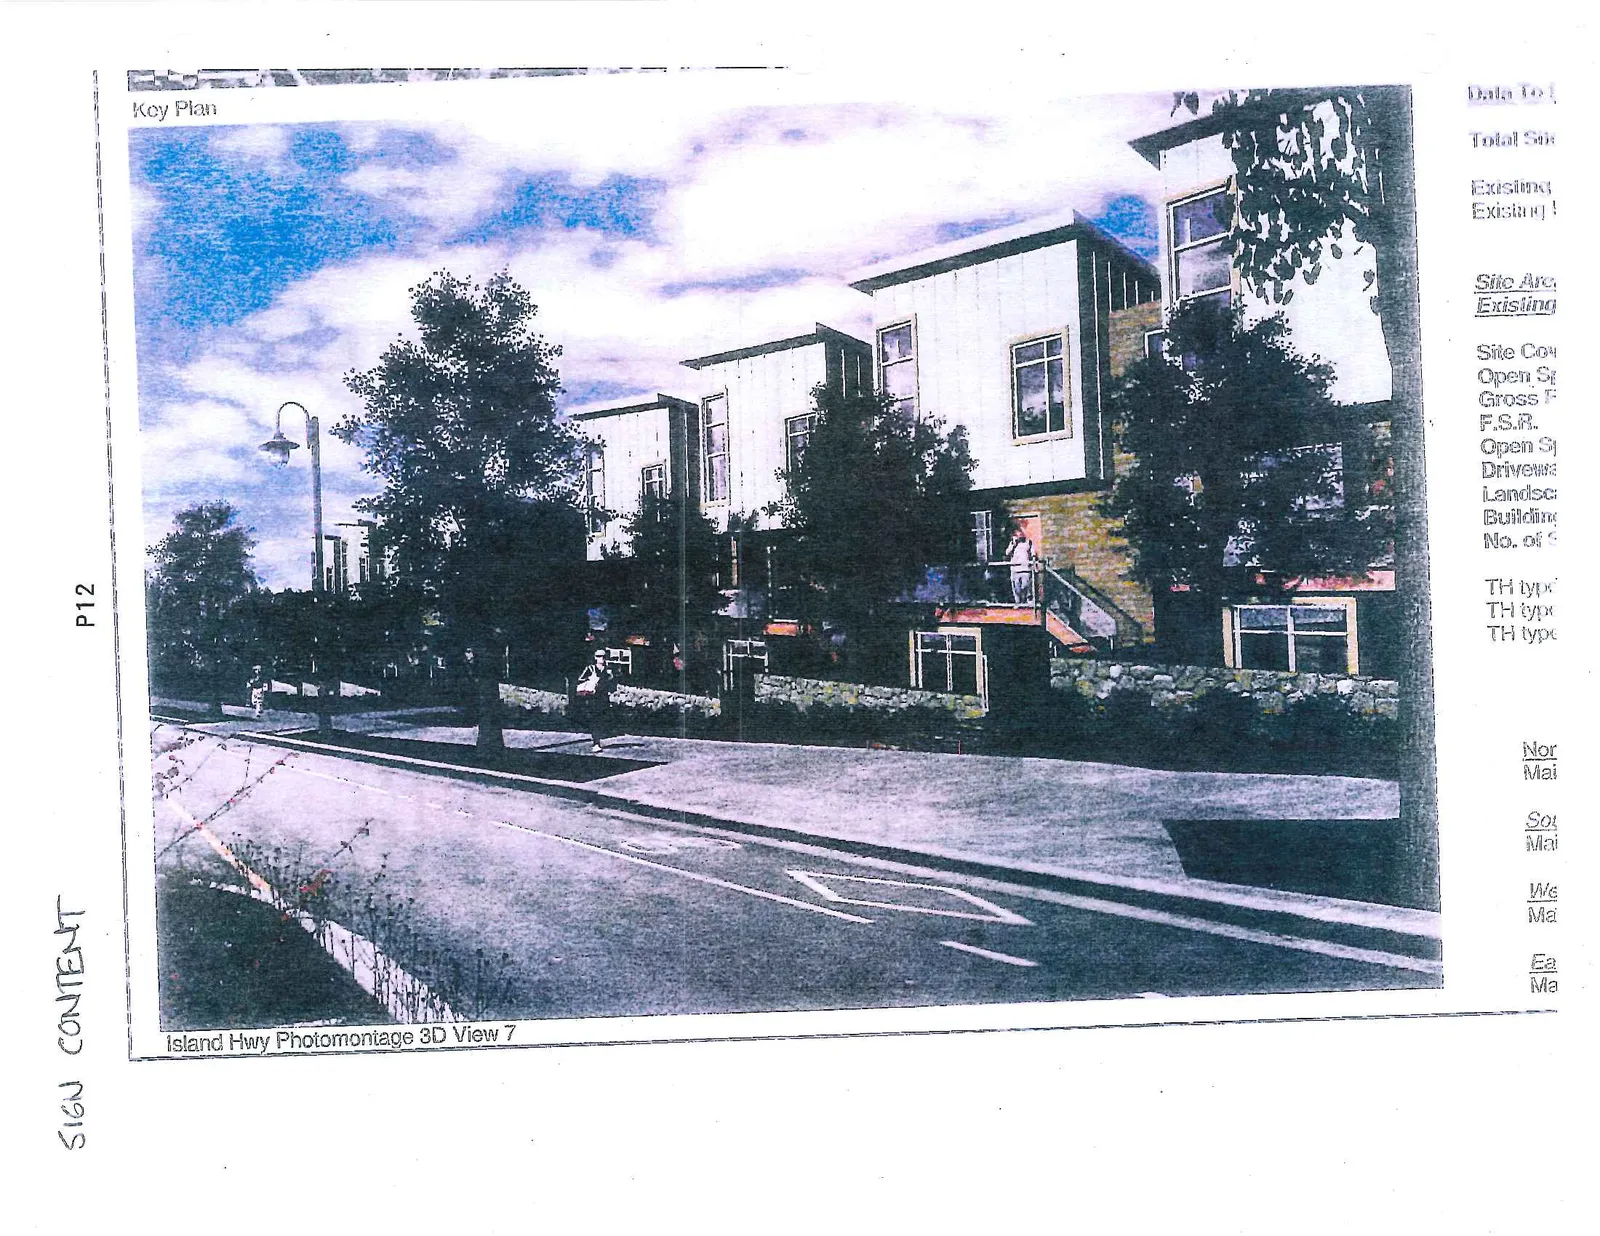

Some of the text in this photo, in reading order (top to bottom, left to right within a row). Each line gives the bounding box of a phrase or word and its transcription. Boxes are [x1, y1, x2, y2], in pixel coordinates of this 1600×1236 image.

[133, 100, 217, 121] Key Plan
[1469, 130, 1518, 148] Total
[1471, 180, 1552, 198] Existing
[1472, 202, 1545, 221] Existing
[1475, 274, 1516, 289] Site
[1476, 296, 1556, 315] Existing
[1477, 344, 1516, 360] Site
[1478, 367, 1531, 388] Open
[1479, 391, 1539, 407] Gross
[1480, 413, 1539, 430] F.S.R.
[1481, 438, 1533, 458] Open
[1483, 484, 1557, 502] Landsc
[1484, 532, 1517, 549] No.
[1523, 531, 1543, 548] of
[1485, 578, 1513, 595] TH
[75, 583, 95, 627] P12
[1486, 602, 1514, 618] TH
[1487, 625, 1515, 641] TH
[1523, 741, 1557, 758] Nor
[1524, 764, 1557, 780] Mai
[1532, 954, 1557, 970] Ea
[1531, 977, 1557, 994] Ma
[56, 893, 86, 1151] SIGN CONTENT
[166, 1025, 517, 1053] Island Hwy Photomontage 3D View 7
